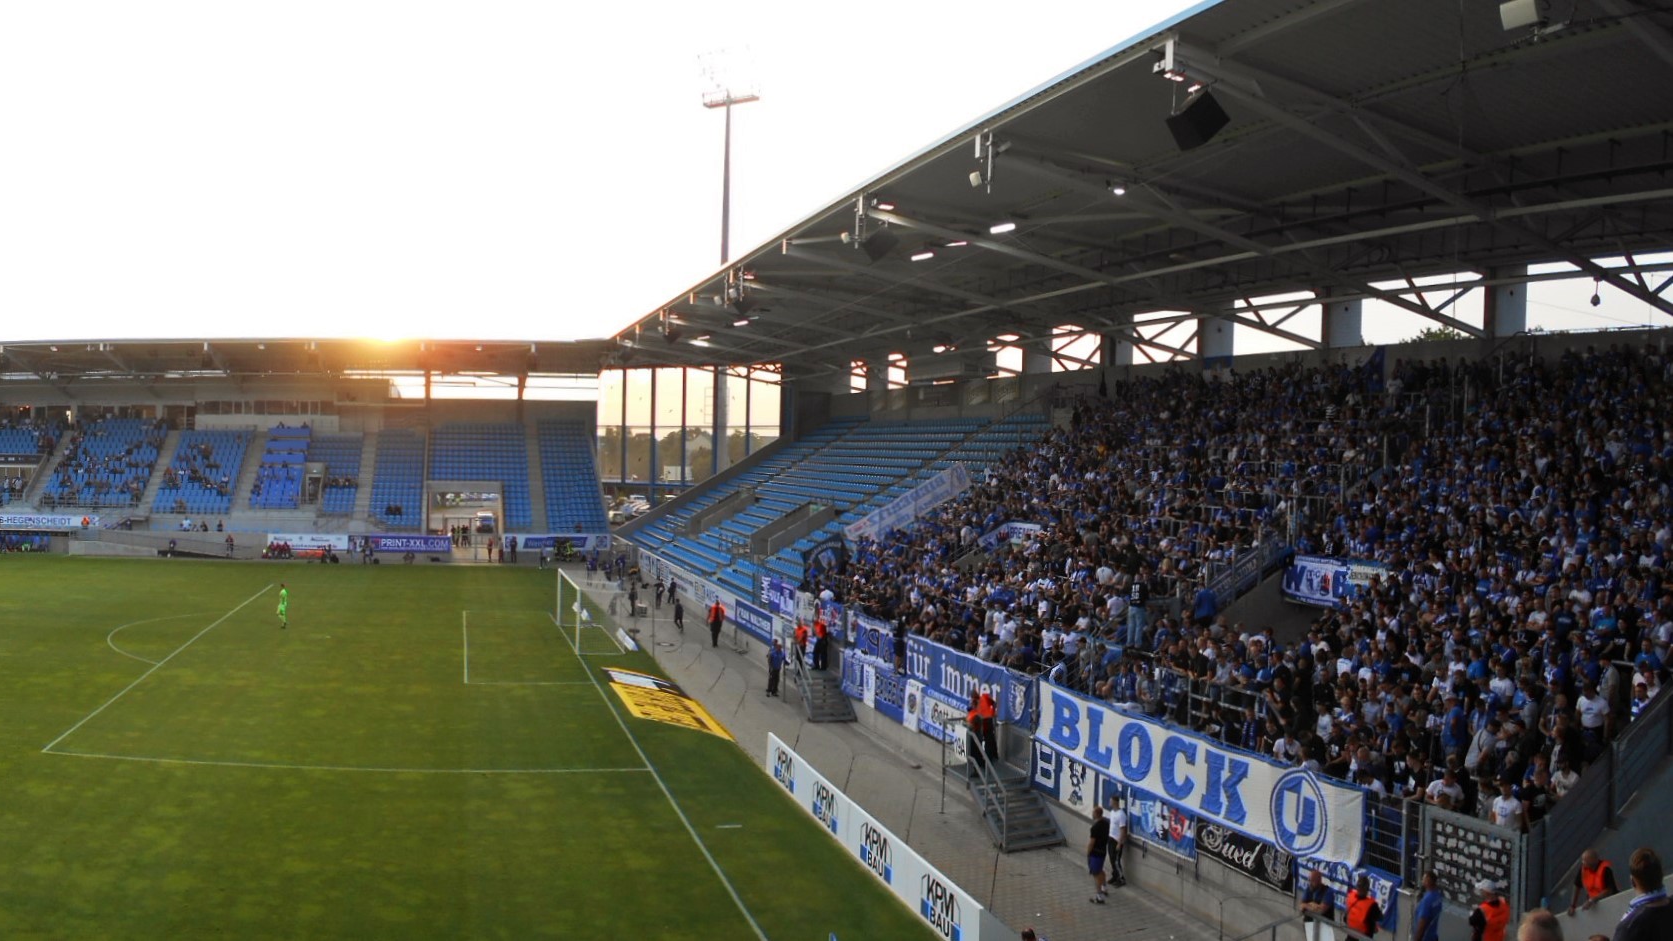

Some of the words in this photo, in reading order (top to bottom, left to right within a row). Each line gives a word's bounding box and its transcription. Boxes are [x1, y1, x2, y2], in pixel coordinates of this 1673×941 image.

[381, 538, 449, 548] PRINT-XXL.COM
[907, 640, 930, 681] für
[940, 653, 1001, 703] immer
[777, 749, 793, 777] KPM
[1049, 689, 1249, 826] BLOCK
[816, 784, 834, 816] KPM
[818, 806, 831, 829] BAU
[864, 824, 887, 863] KPM
[867, 850, 884, 877] BAU
[927, 874, 955, 922] KPM
[929, 905, 950, 938] BAU
